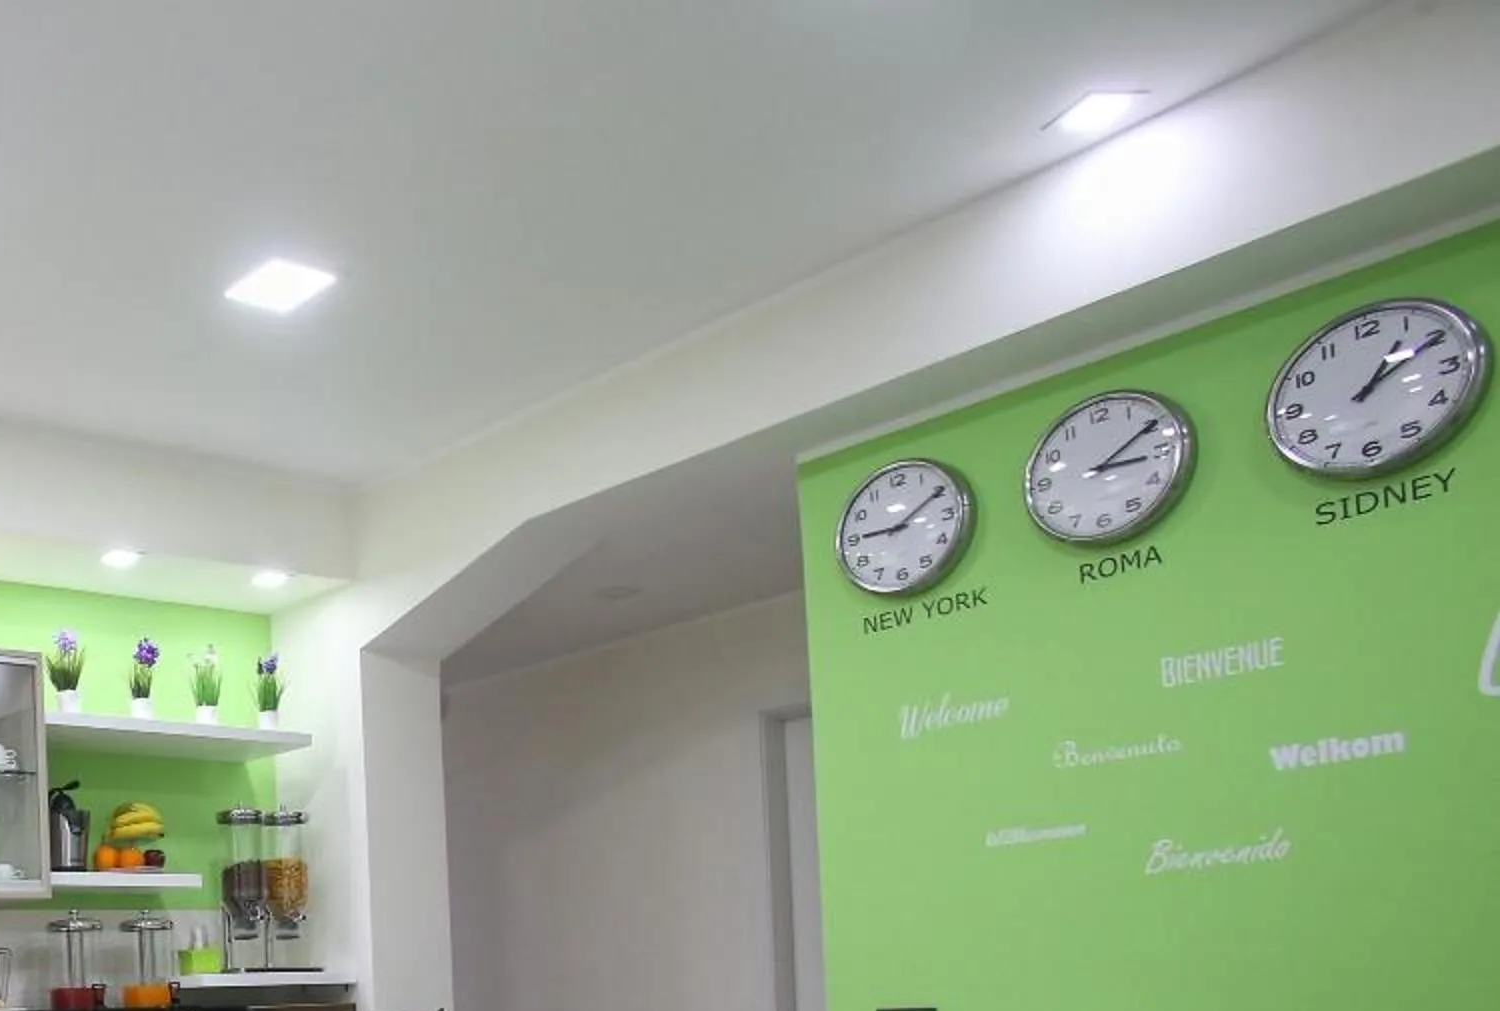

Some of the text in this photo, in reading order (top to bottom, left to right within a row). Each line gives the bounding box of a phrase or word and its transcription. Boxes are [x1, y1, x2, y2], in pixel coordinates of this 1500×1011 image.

[1354, 319, 1381, 341] 12
[1403, 315, 1410, 333] 1
[1424, 329, 1447, 347] 2
[1321, 343, 1335, 361] 11
[1438, 355, 1461, 375] 3
[1295, 370, 1316, 389] 10
[1428, 389, 1449, 407] 4
[1089, 408, 1110, 425] 12
[1285, 403, 1304, 420] 9
[1064, 426, 1077, 441] 11
[1299, 429, 1318, 445] 8
[1401, 420, 1422, 438] 5
[1325, 443, 1342, 459] 7
[1361, 441, 1383, 457] 6
[1045, 450, 1061, 465] 10
[889, 473, 908, 488] 12
[1037, 477, 1053, 493] 9
[1146, 471, 1161, 486] 4
[869, 488, 880, 503] 11
[1315, 467, 1457, 526] SIDNEY
[1048, 500, 1063, 515] 8
[1125, 497, 1141, 513] 5
[941, 507, 956, 522] 3
[1068, 514, 1082, 529] 7
[1096, 513, 1112, 528] 6
[847, 534, 861, 548] 9
[936, 532, 949, 546] 4
[856, 554, 870, 568] 8
[918, 554, 933, 569] 5
[1078, 545, 1164, 585] ROMA
[873, 567, 885, 581] 7
[896, 567, 909, 581] 6
[862, 584, 989, 635] NEW YORK
[1160, 636, 1286, 688] BIENVENUE
[899, 690, 1011, 740] Welcome
[1267, 730, 1406, 771] Welkom
[1144, 825, 1292, 876] Bienvenido
